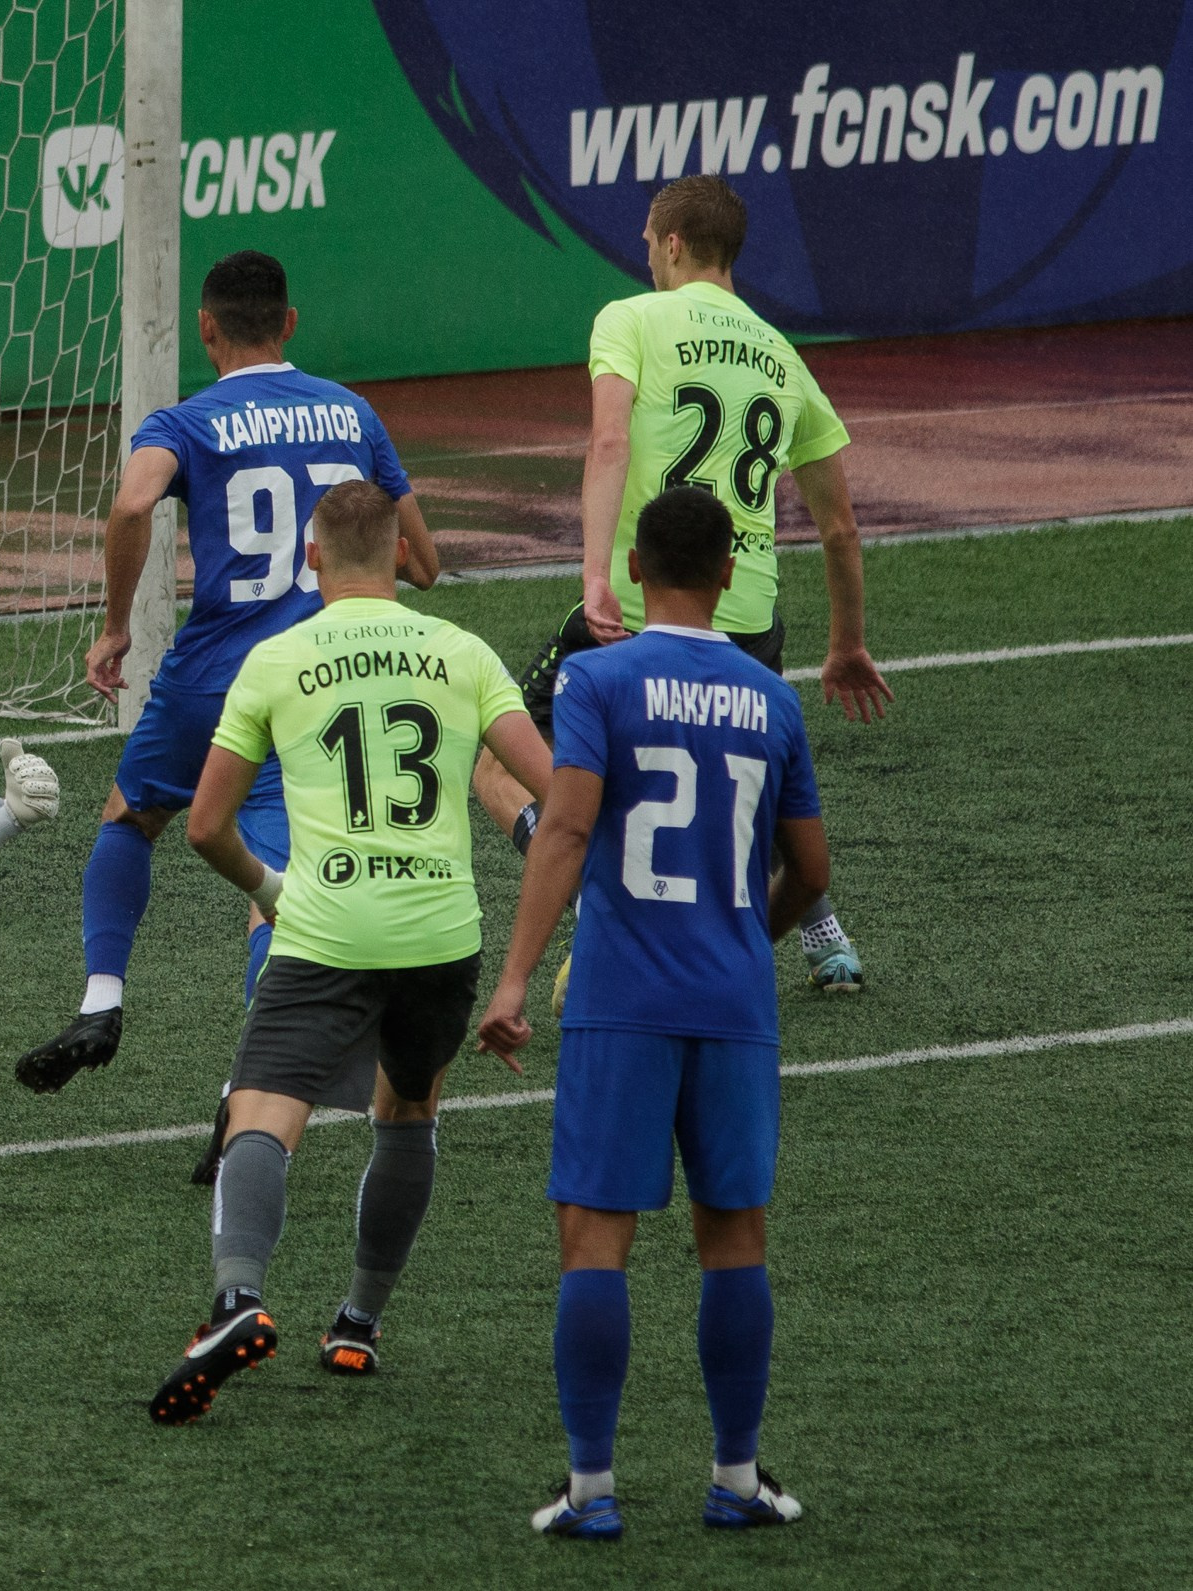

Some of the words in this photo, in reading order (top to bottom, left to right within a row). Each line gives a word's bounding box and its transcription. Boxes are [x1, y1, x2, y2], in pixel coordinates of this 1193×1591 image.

[570, 52, 1164, 187] www.fcnsk.com
[181, 130, 337, 219] CNSK
[675, 339, 787, 389] БУРЛАКОВ
[211, 400, 362, 452] ХАЙРУЛЛОВ
[661, 382, 785, 513] 28
[315, 630, 338, 646] LF
[344, 625, 414, 641] GROUP
[298, 650, 449, 696] СОЛОМАХА
[645, 678, 768, 734] МАКУРИН
[316, 699, 443, 834] 13
[623, 747, 768, 908] 21
